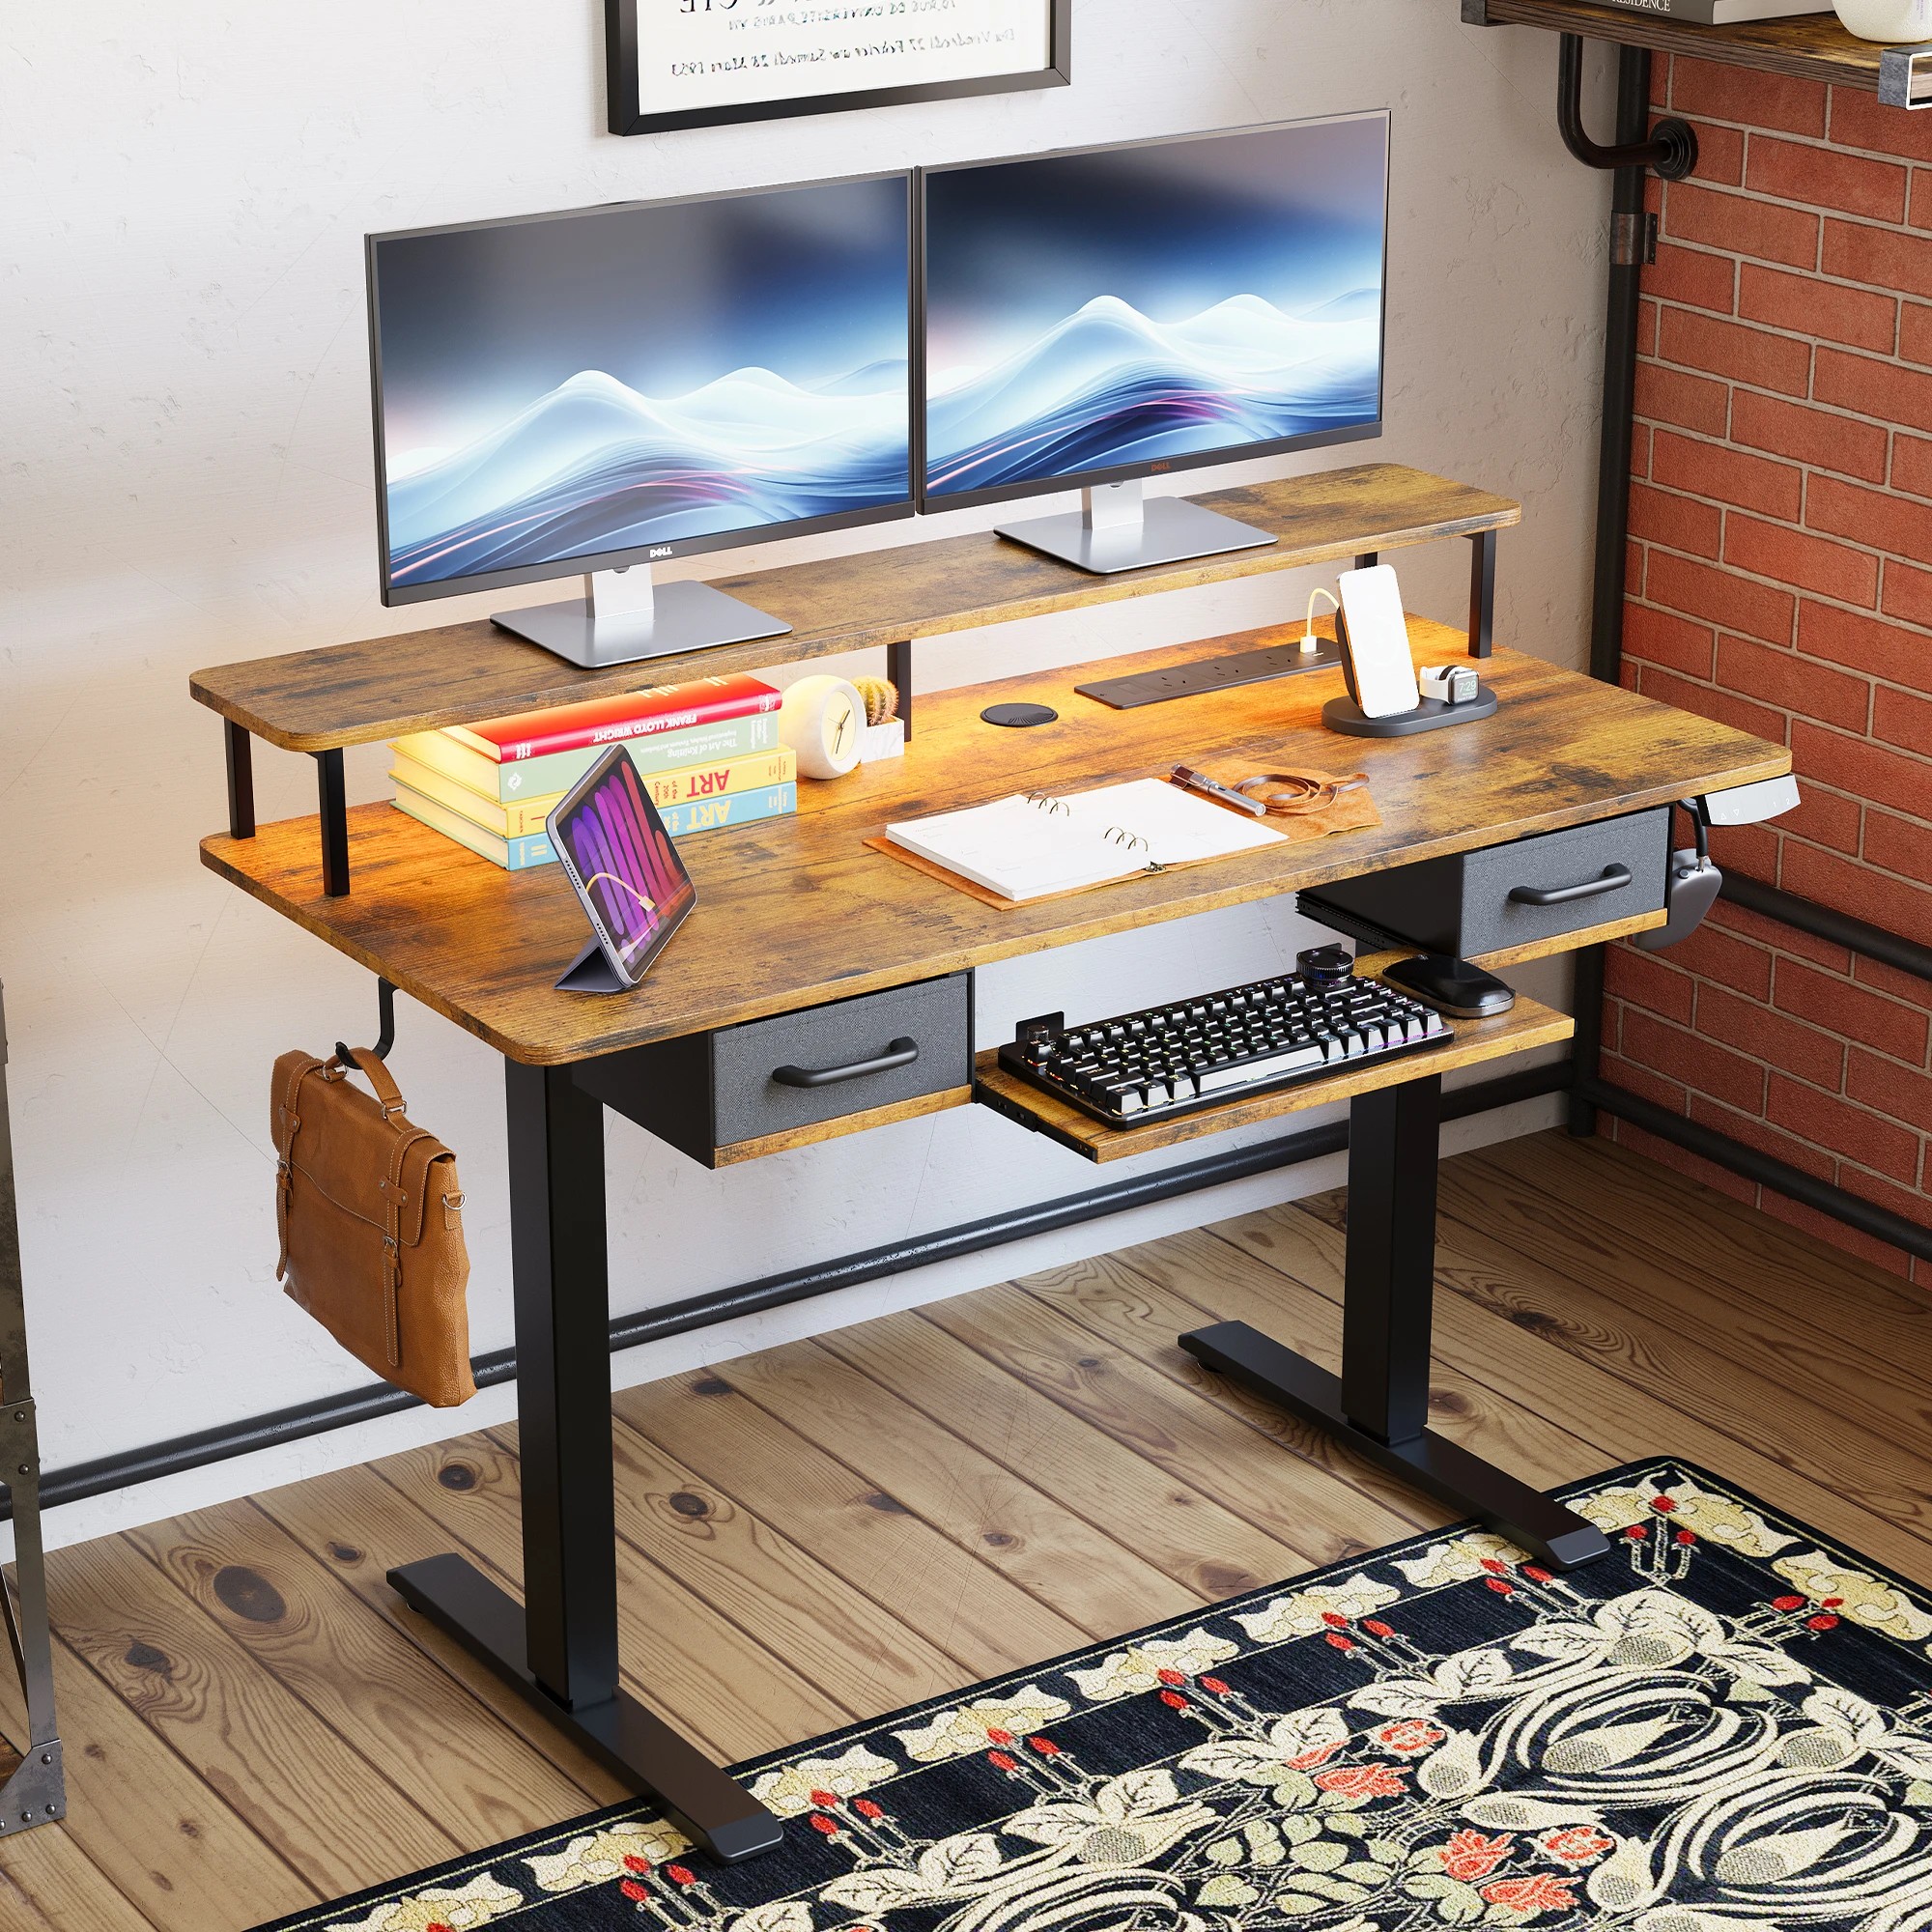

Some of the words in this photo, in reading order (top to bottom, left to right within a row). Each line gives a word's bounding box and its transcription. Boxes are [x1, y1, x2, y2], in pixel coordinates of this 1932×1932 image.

[1612, 0, 1671, 12] DENCE
[649, 546, 673, 558] DELL
[1459, 679, 1477, 694] 7:29
[633, 720, 665, 734] LLOYD
[665, 714, 697, 728] FRANK
[593, 724, 635, 743] WRIGHT
[698, 744, 707, 753] of
[708, 740, 723, 752] Art
[722, 738, 738, 749] The
[667, 746, 697, 758] Knitting
[687, 769, 730, 798] ART
[686, 799, 732, 831] ART
